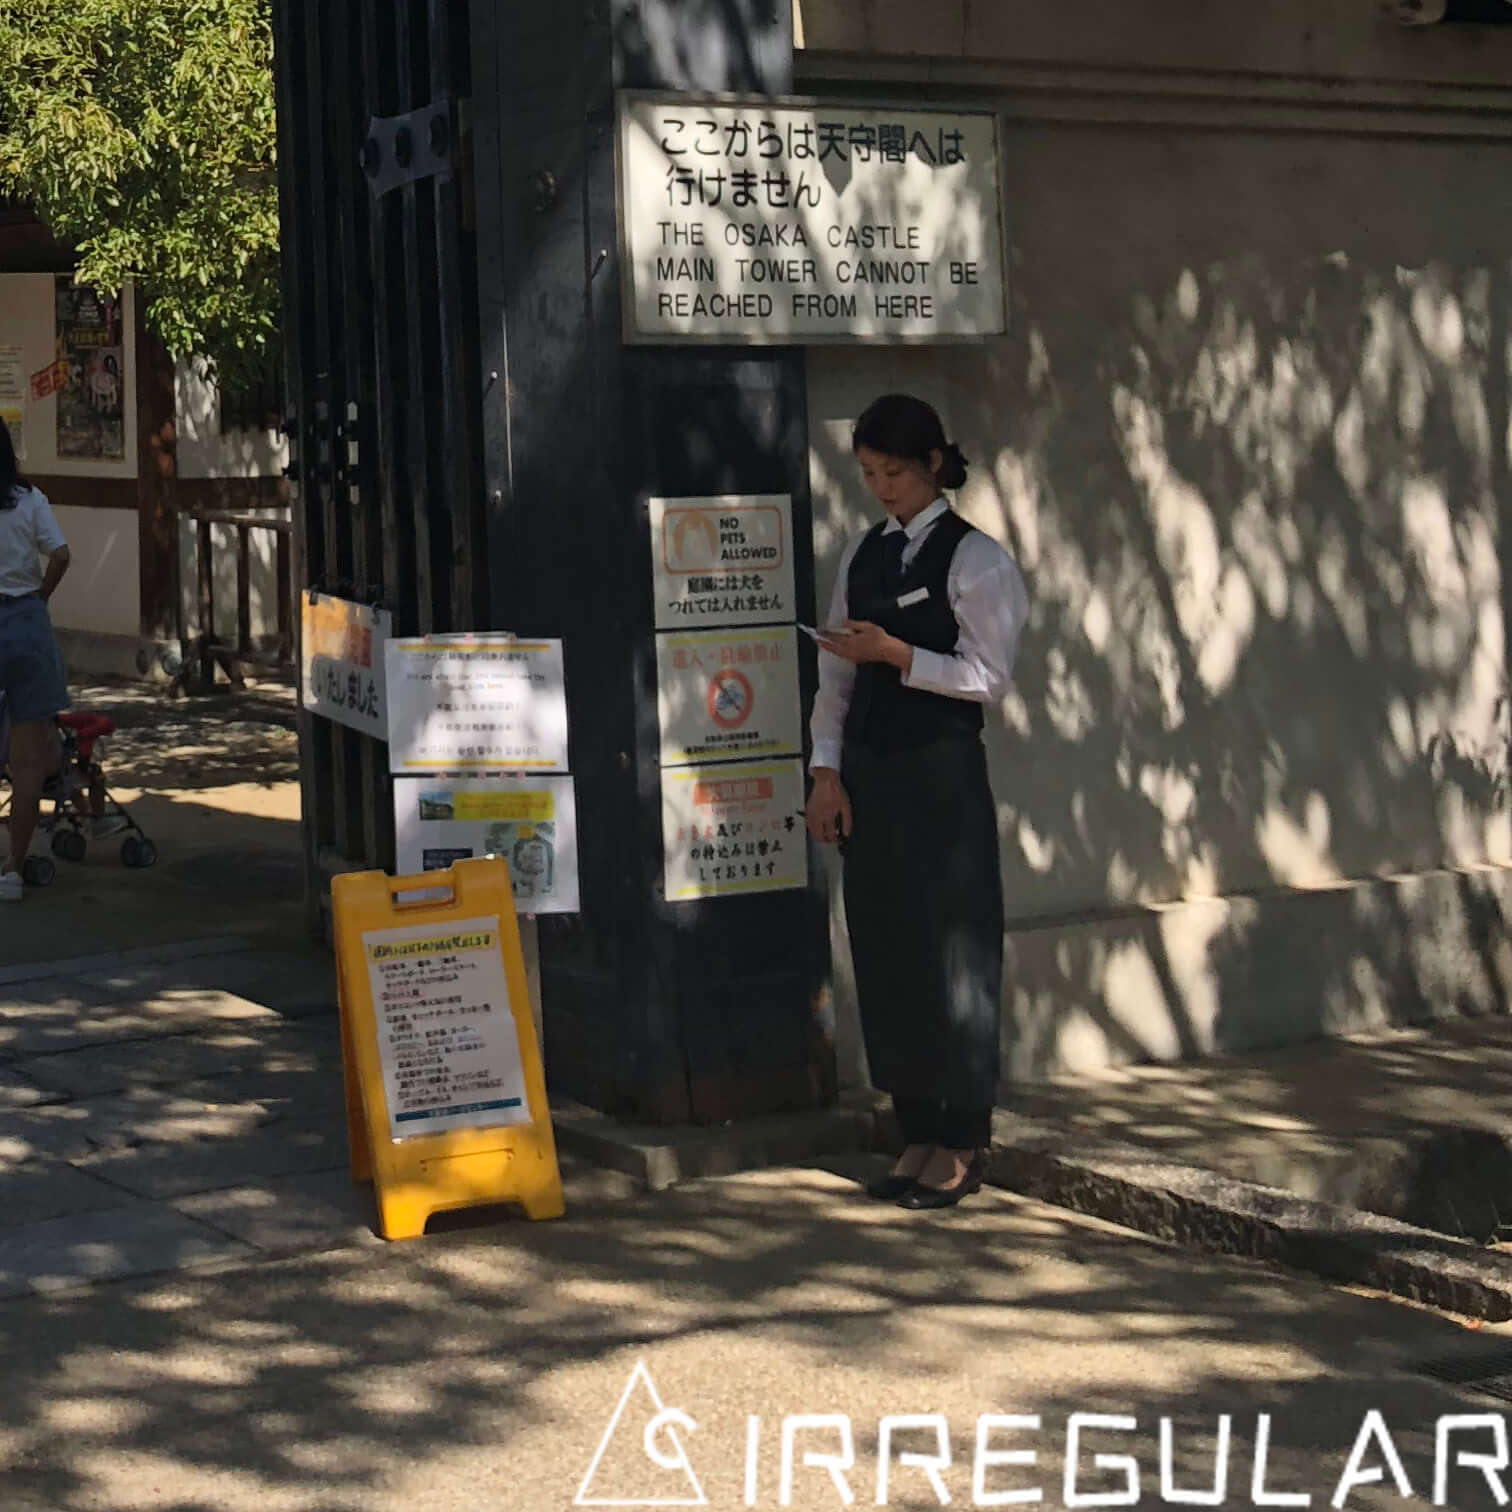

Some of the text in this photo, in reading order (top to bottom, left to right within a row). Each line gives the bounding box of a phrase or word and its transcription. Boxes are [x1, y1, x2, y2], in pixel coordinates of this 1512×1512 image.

[661, 119, 967, 165] ここからは天守閣へは
[665, 165, 821, 208] 行けません
[657, 222, 920, 249] THE OSAKA CASTLE
[656, 258, 978, 284] MAIN TOWER CANNOT BE
[659, 294, 934, 318] REACHED FROM HERE
[720, 518, 739, 529] NO
[720, 532, 746, 544] PETS
[721, 547, 777, 560] ALLOWED
[668, 593, 784, 615] つれては入れません
